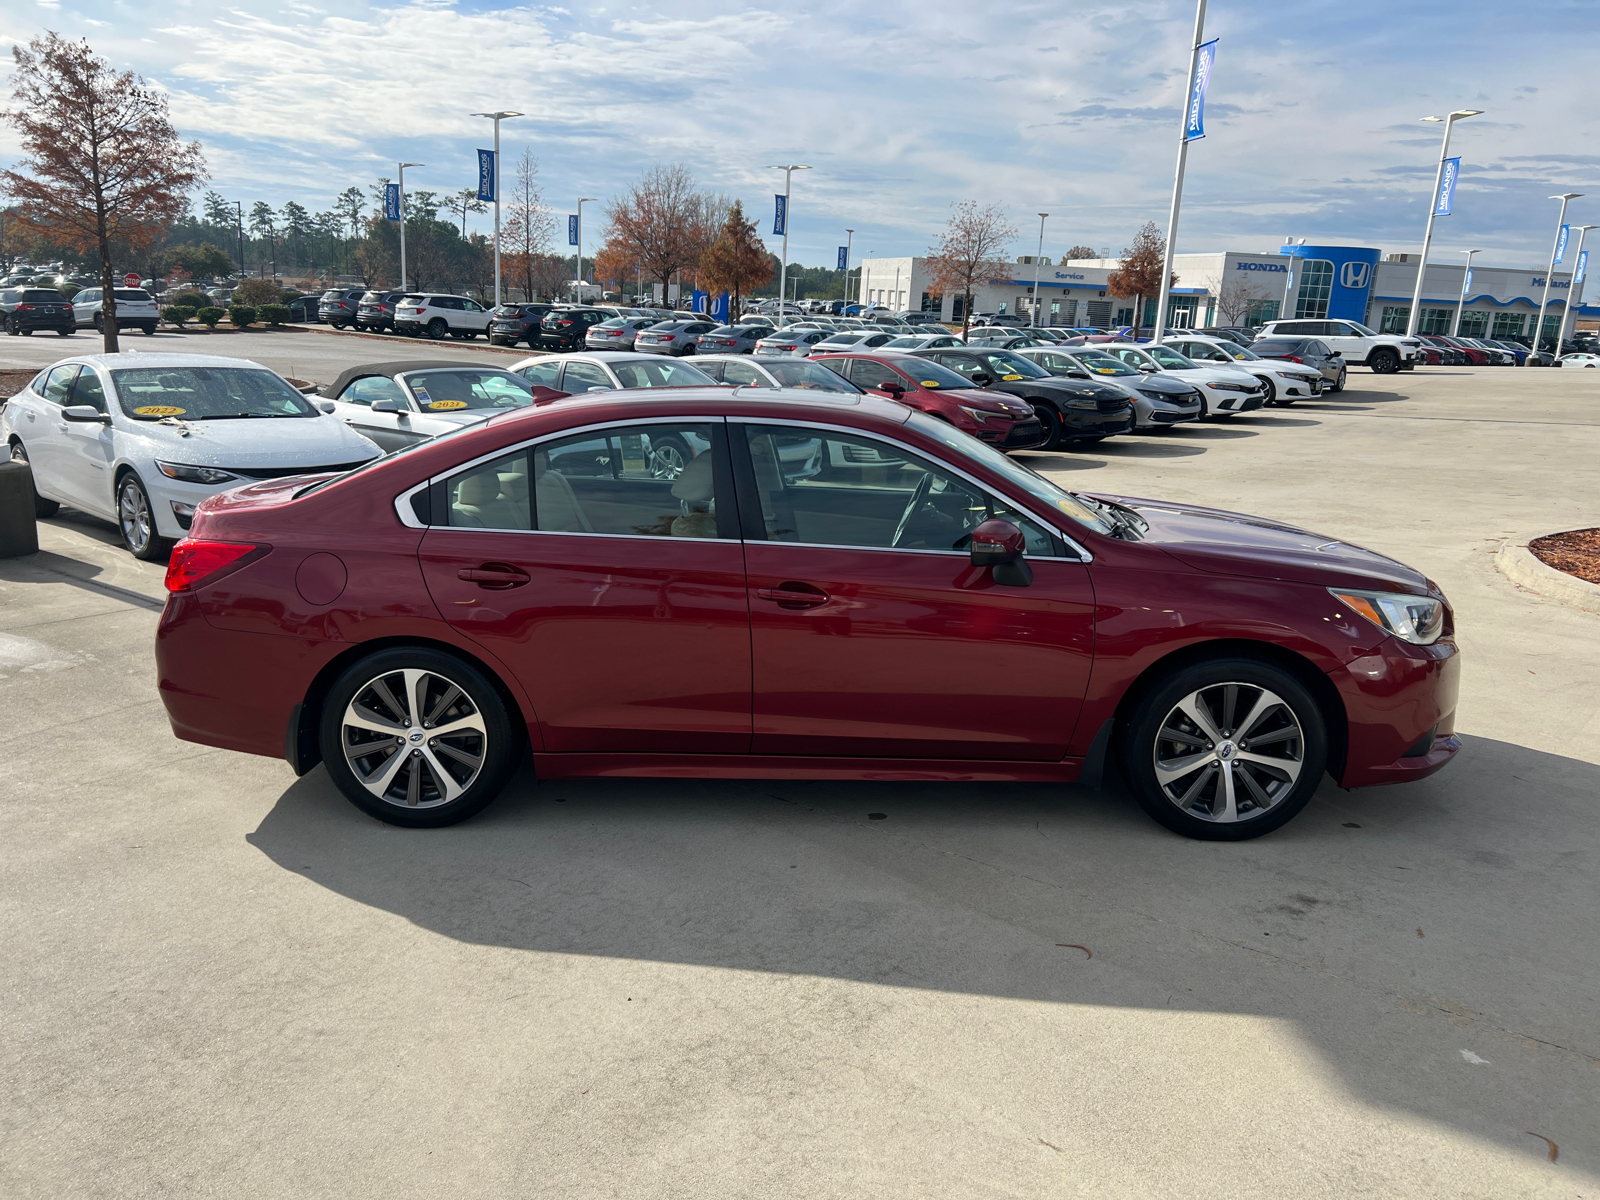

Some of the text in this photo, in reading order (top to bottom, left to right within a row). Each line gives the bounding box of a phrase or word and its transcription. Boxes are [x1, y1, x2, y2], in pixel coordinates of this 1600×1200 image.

[1189, 50, 1208, 131] MIDLANDS
[1439, 162, 1453, 210] MIDLANDS
[1236, 262, 1288, 273] HONDA
[1055, 272, 1085, 280] Service
[125, 278, 140, 286] STOP
